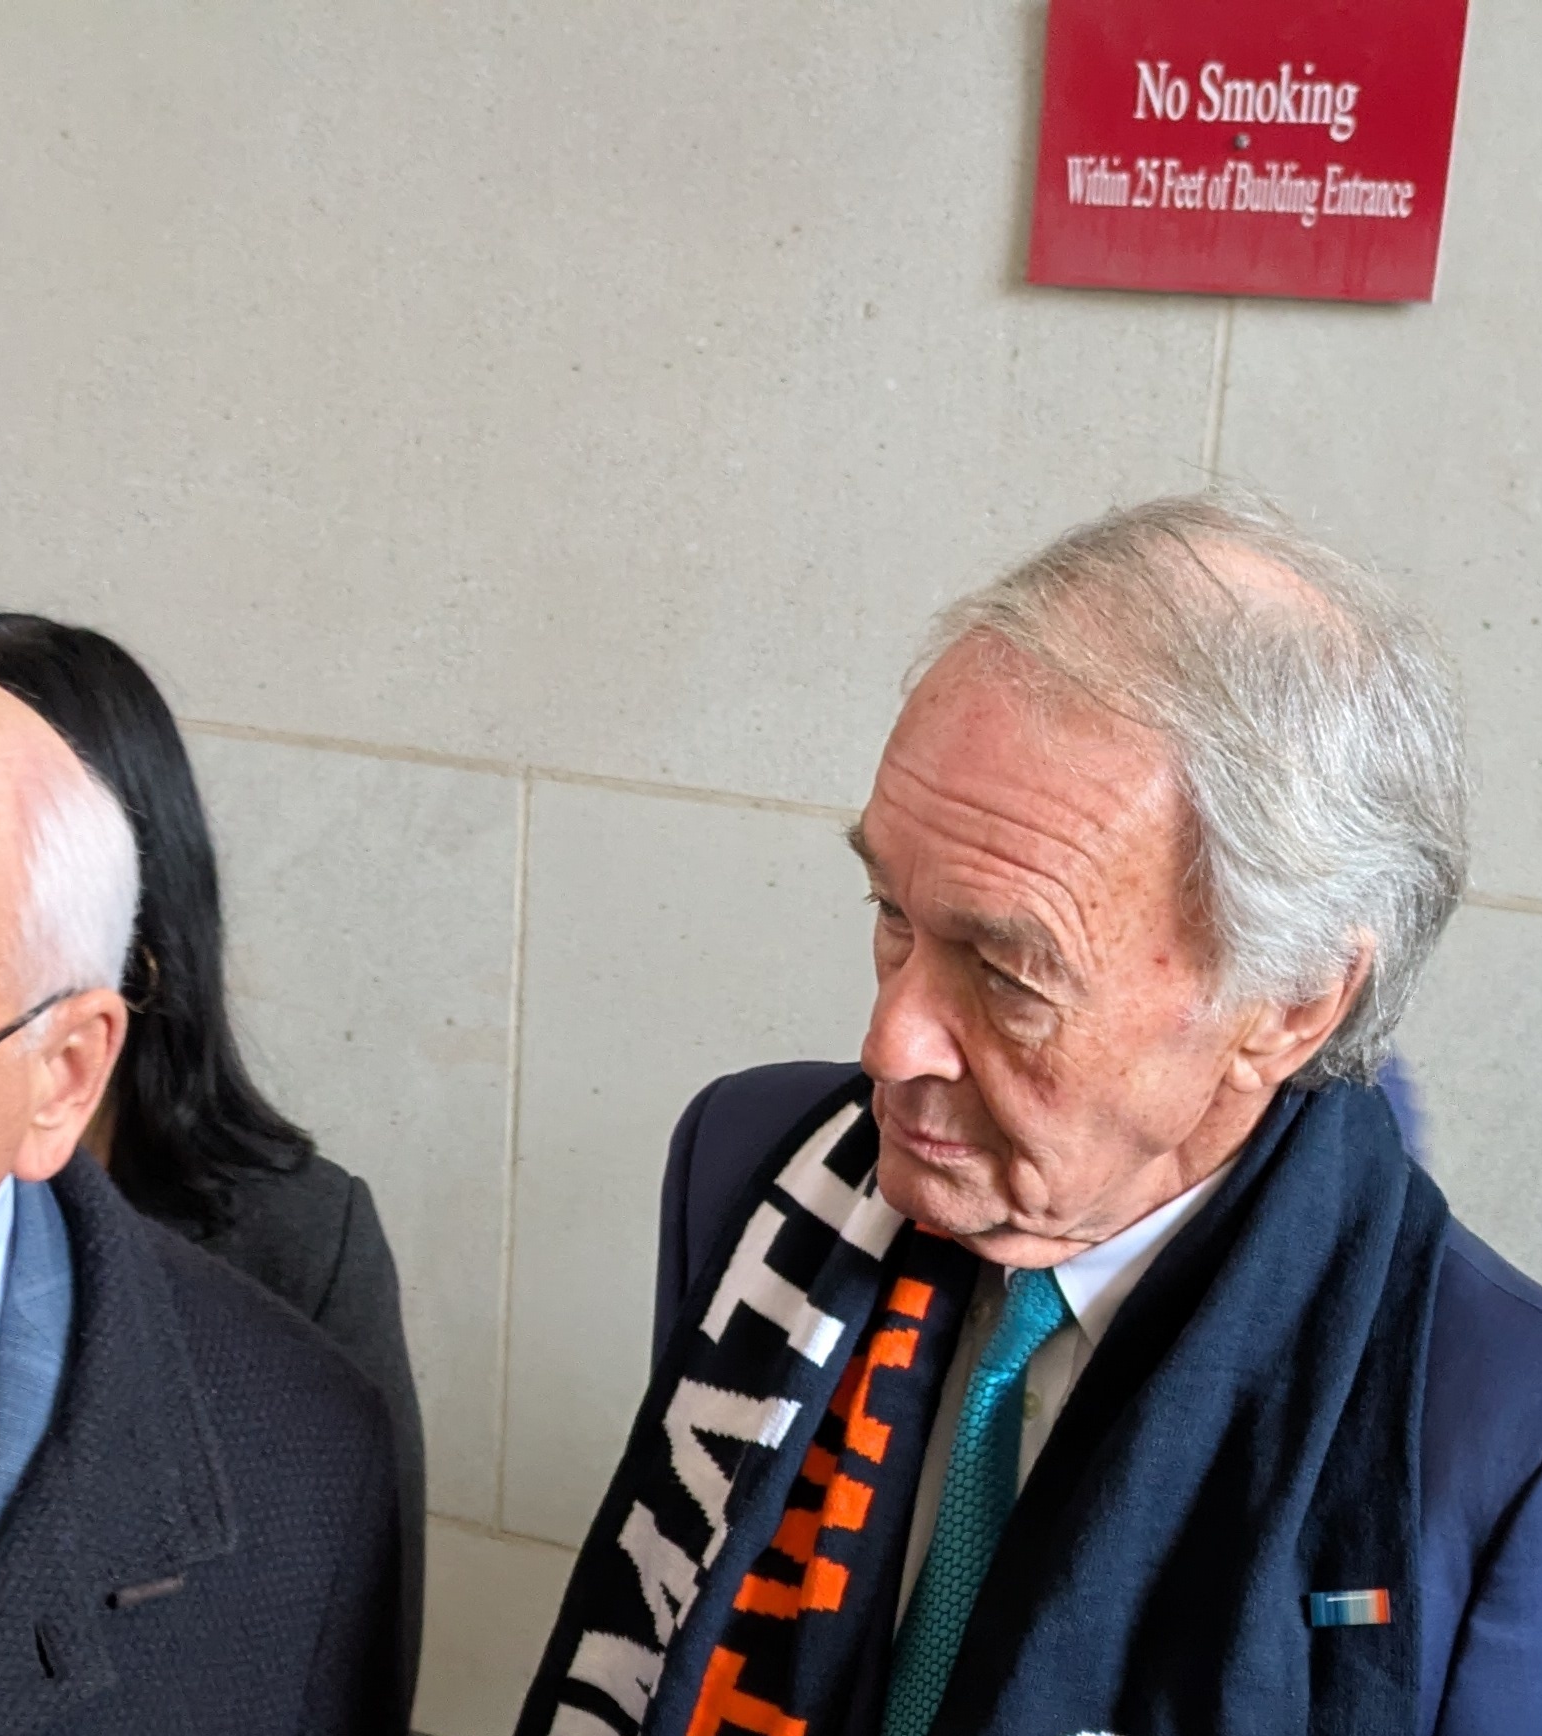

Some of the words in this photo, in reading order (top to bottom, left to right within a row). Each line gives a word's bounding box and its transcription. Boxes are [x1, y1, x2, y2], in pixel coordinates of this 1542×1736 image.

[1133, 60, 1190, 121] No
[1197, 61, 1361, 142] Smoking
[1066, 155, 1131, 208] Within
[1131, 160, 1161, 208] 25
[1161, 158, 1207, 210] Feet
[1207, 161, 1236, 211] of
[1233, 161, 1321, 227] Building
[1322, 164, 1416, 218] Entrance
